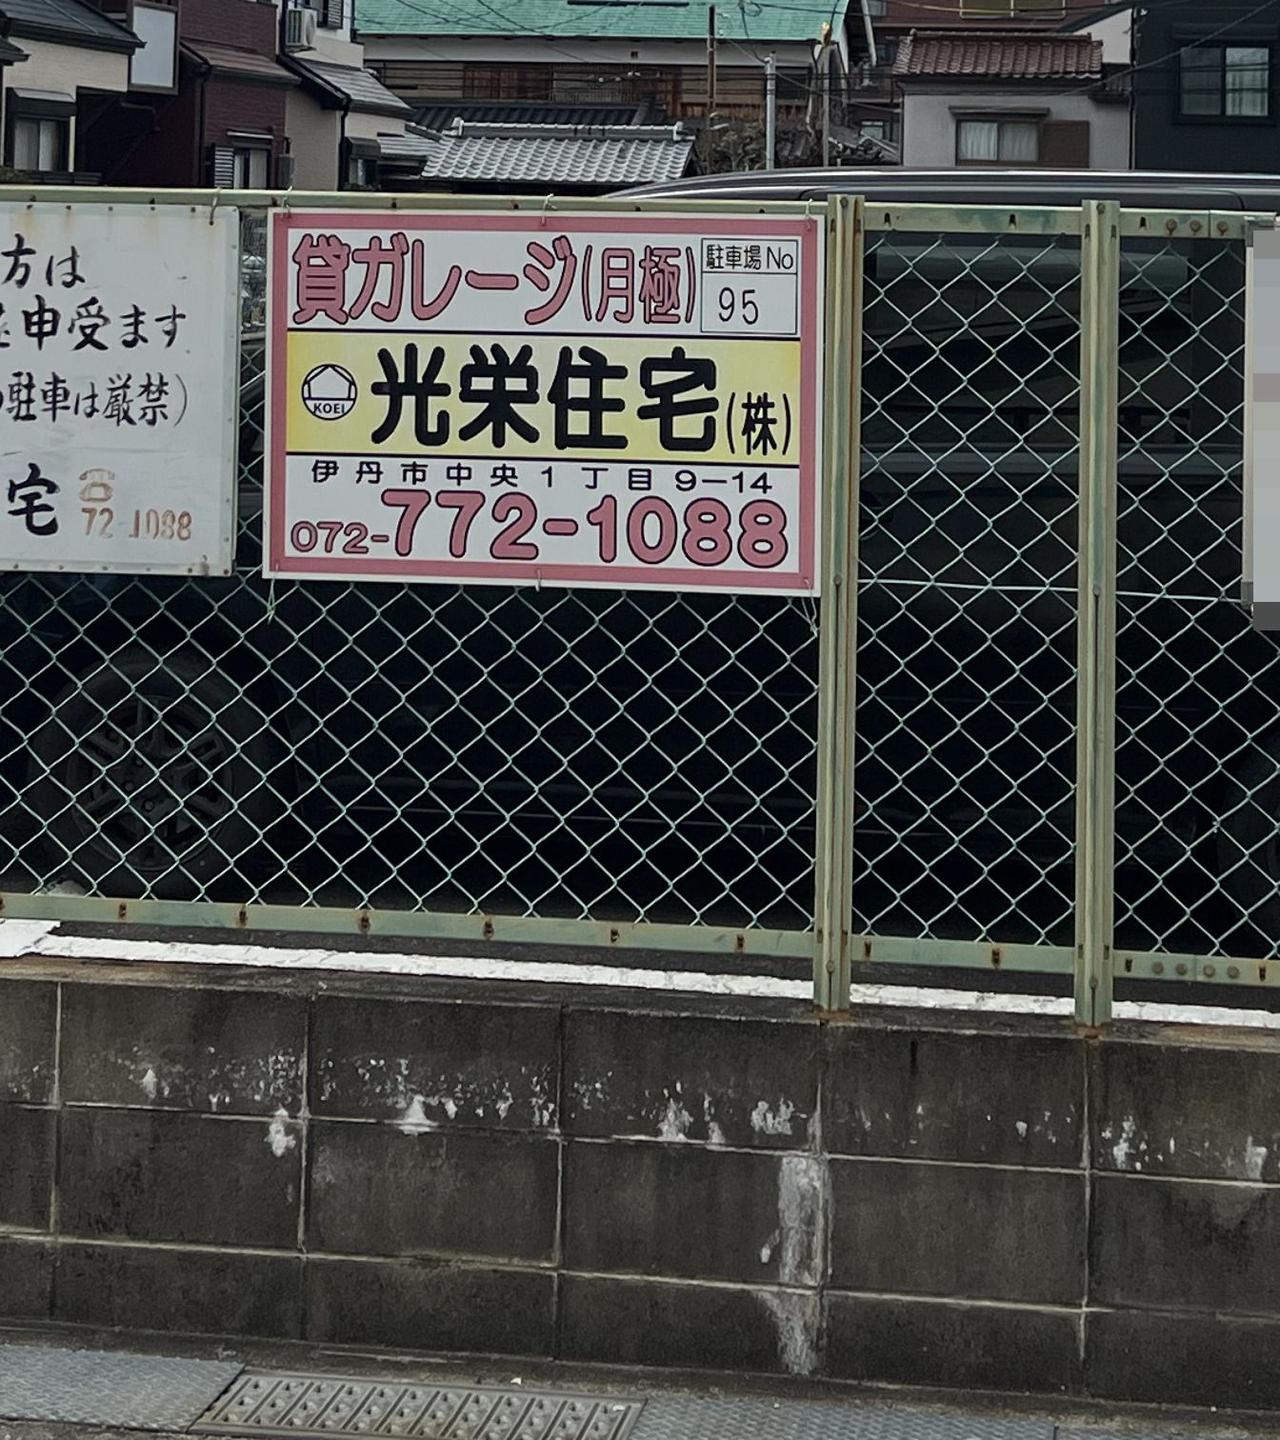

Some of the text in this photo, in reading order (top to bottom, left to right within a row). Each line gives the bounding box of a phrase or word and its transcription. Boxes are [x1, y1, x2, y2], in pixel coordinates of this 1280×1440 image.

[292, 231, 696, 325] 貸ガレージ(月極)
[719, 287, 759, 325] 95
[313, 403, 346, 416] KOEI
[371, 342, 792, 456] 光栄住宅(株)
[81, 507, 114, 538] 72
[291, 488, 789, 568] 072-772-1088
